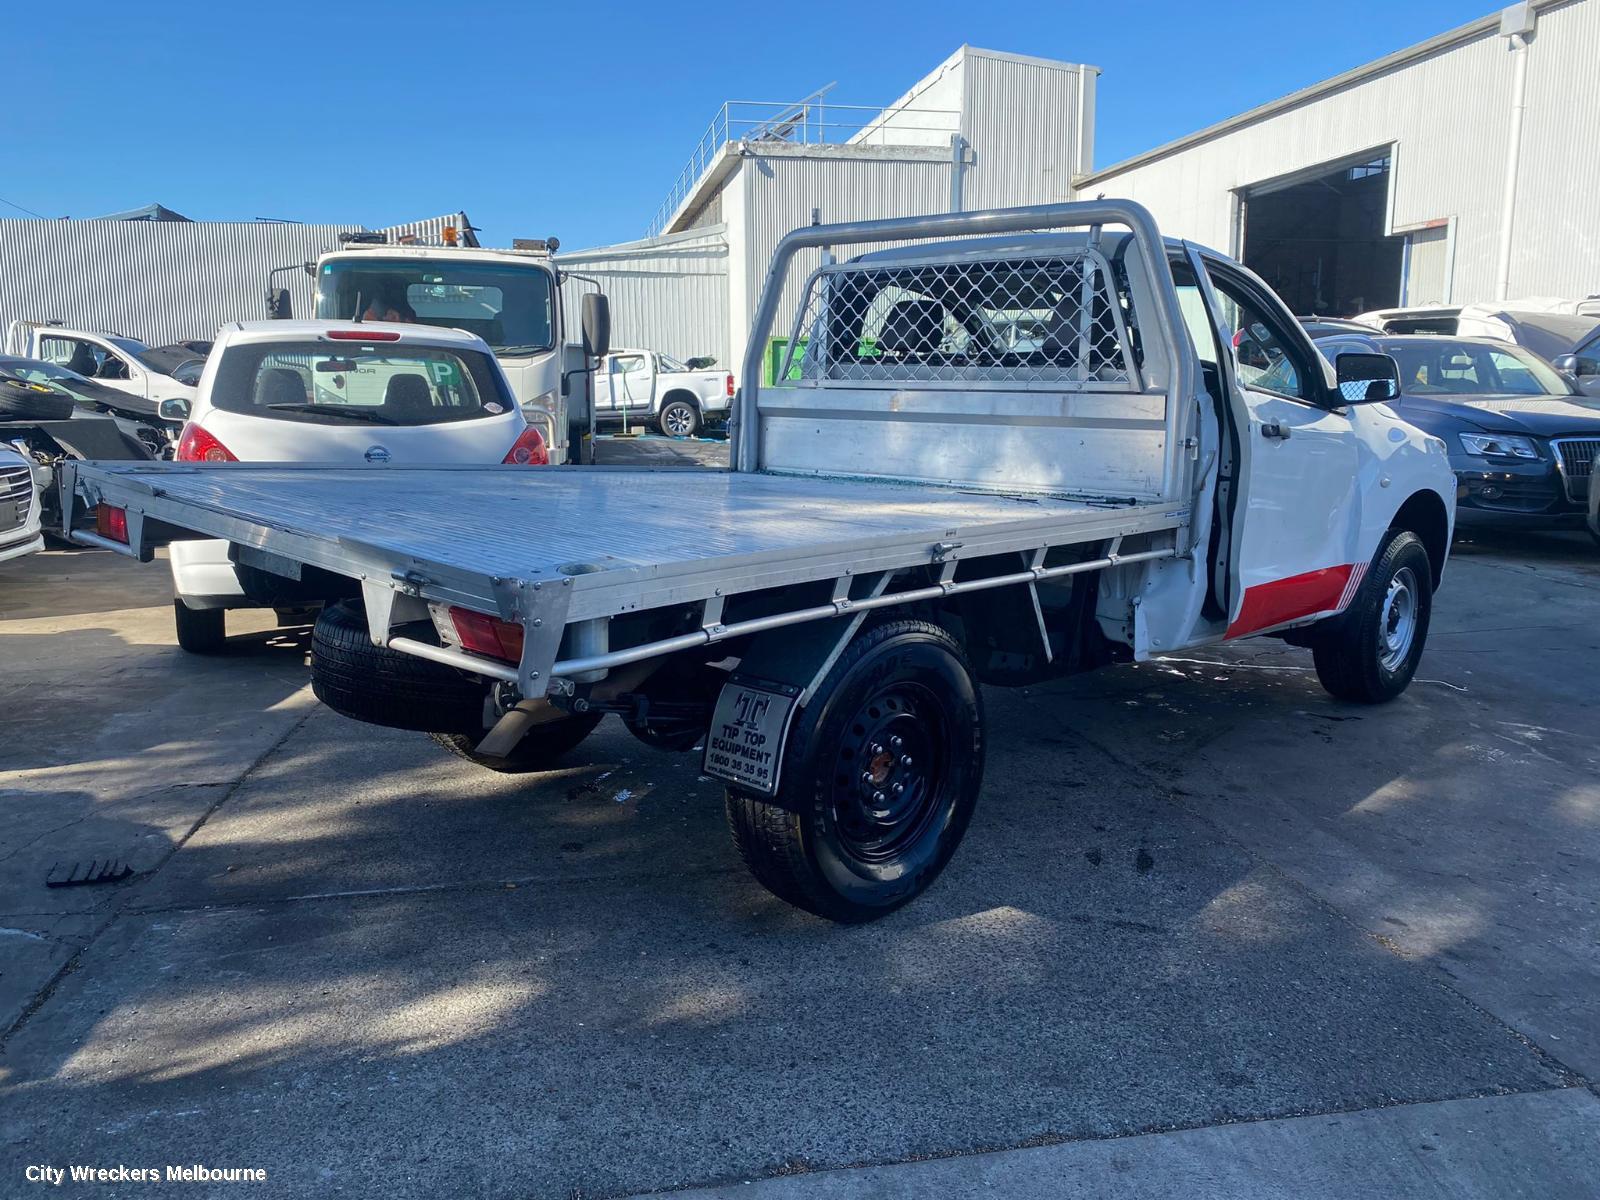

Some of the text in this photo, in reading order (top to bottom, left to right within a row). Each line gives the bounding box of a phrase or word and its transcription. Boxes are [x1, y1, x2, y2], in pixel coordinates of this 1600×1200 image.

[432, 363, 452, 382] P
[722, 724, 767, 747] TIP TOP
[711, 737, 771, 765] EQUIPMENT
[710, 752, 730, 767] 1800
[731, 759, 742, 771] 35
[744, 763, 756, 775] 35
[757, 768, 769, 780] 95
